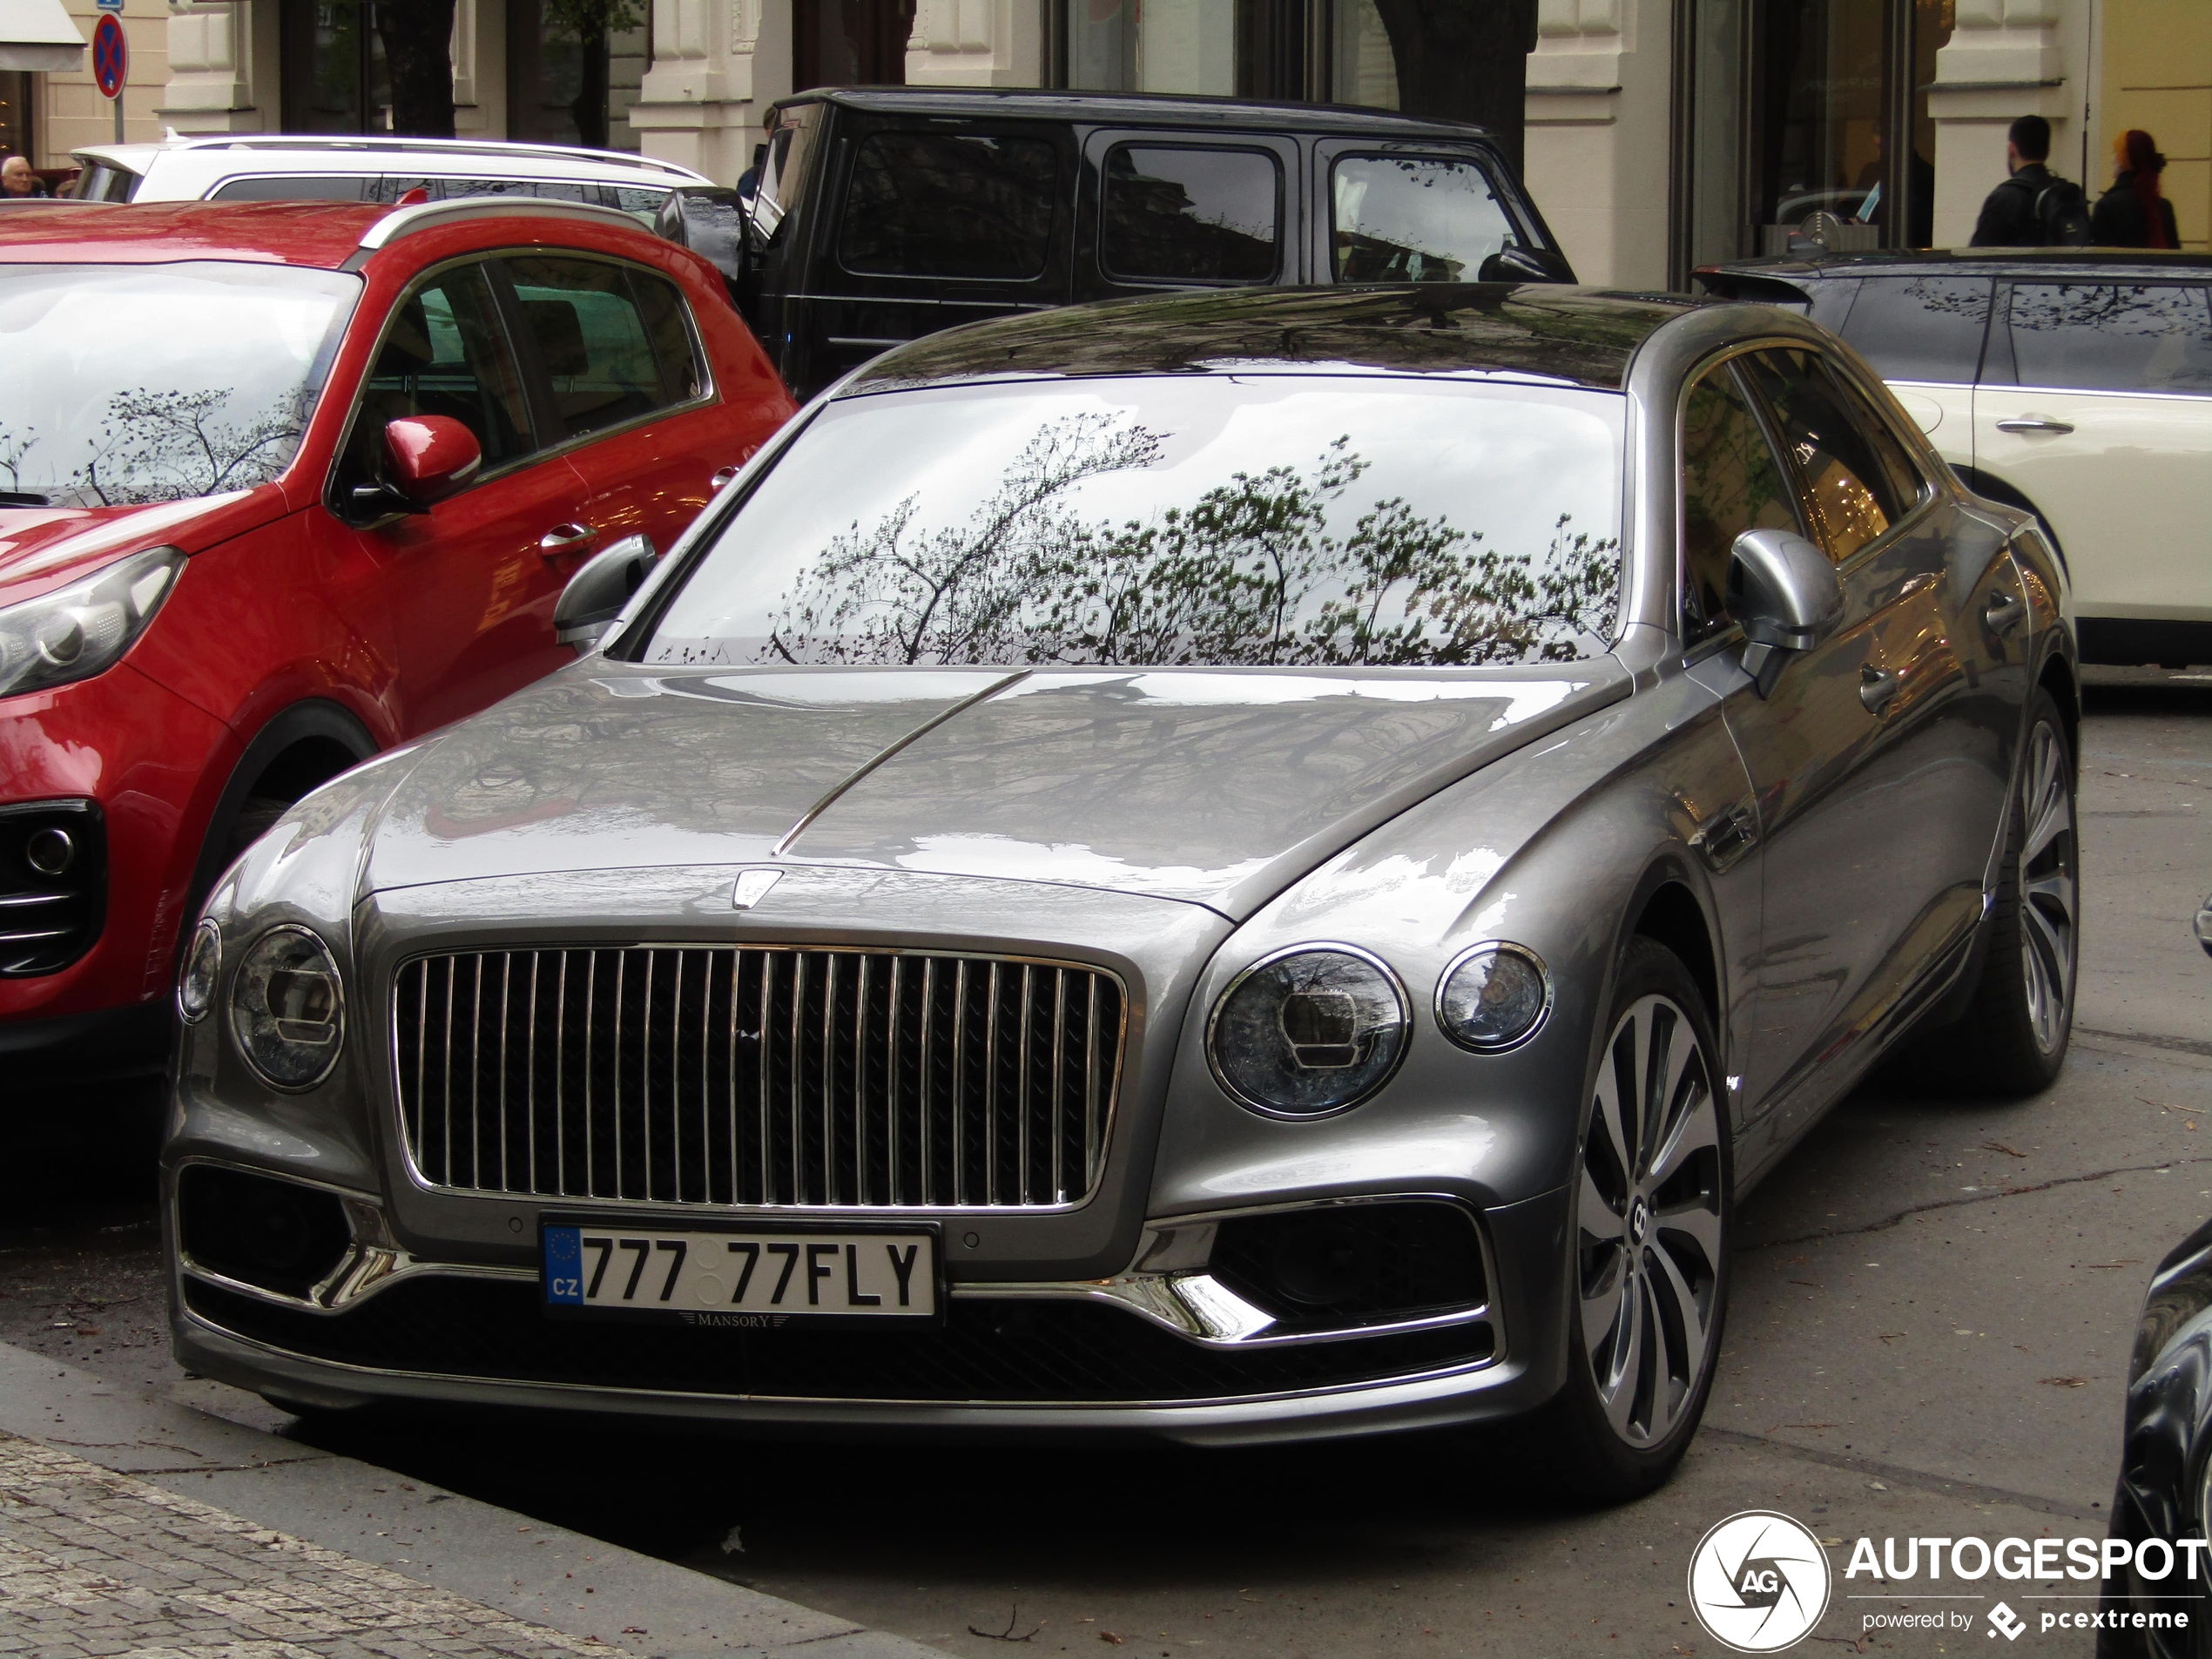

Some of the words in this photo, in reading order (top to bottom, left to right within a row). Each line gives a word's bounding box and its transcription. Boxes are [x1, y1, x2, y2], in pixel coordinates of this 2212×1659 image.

[583, 1237, 688, 1301] 777
[728, 1242, 918, 1305] 77FLY
[553, 1278, 578, 1296] CZ
[698, 1313, 770, 1327] MANSORY
